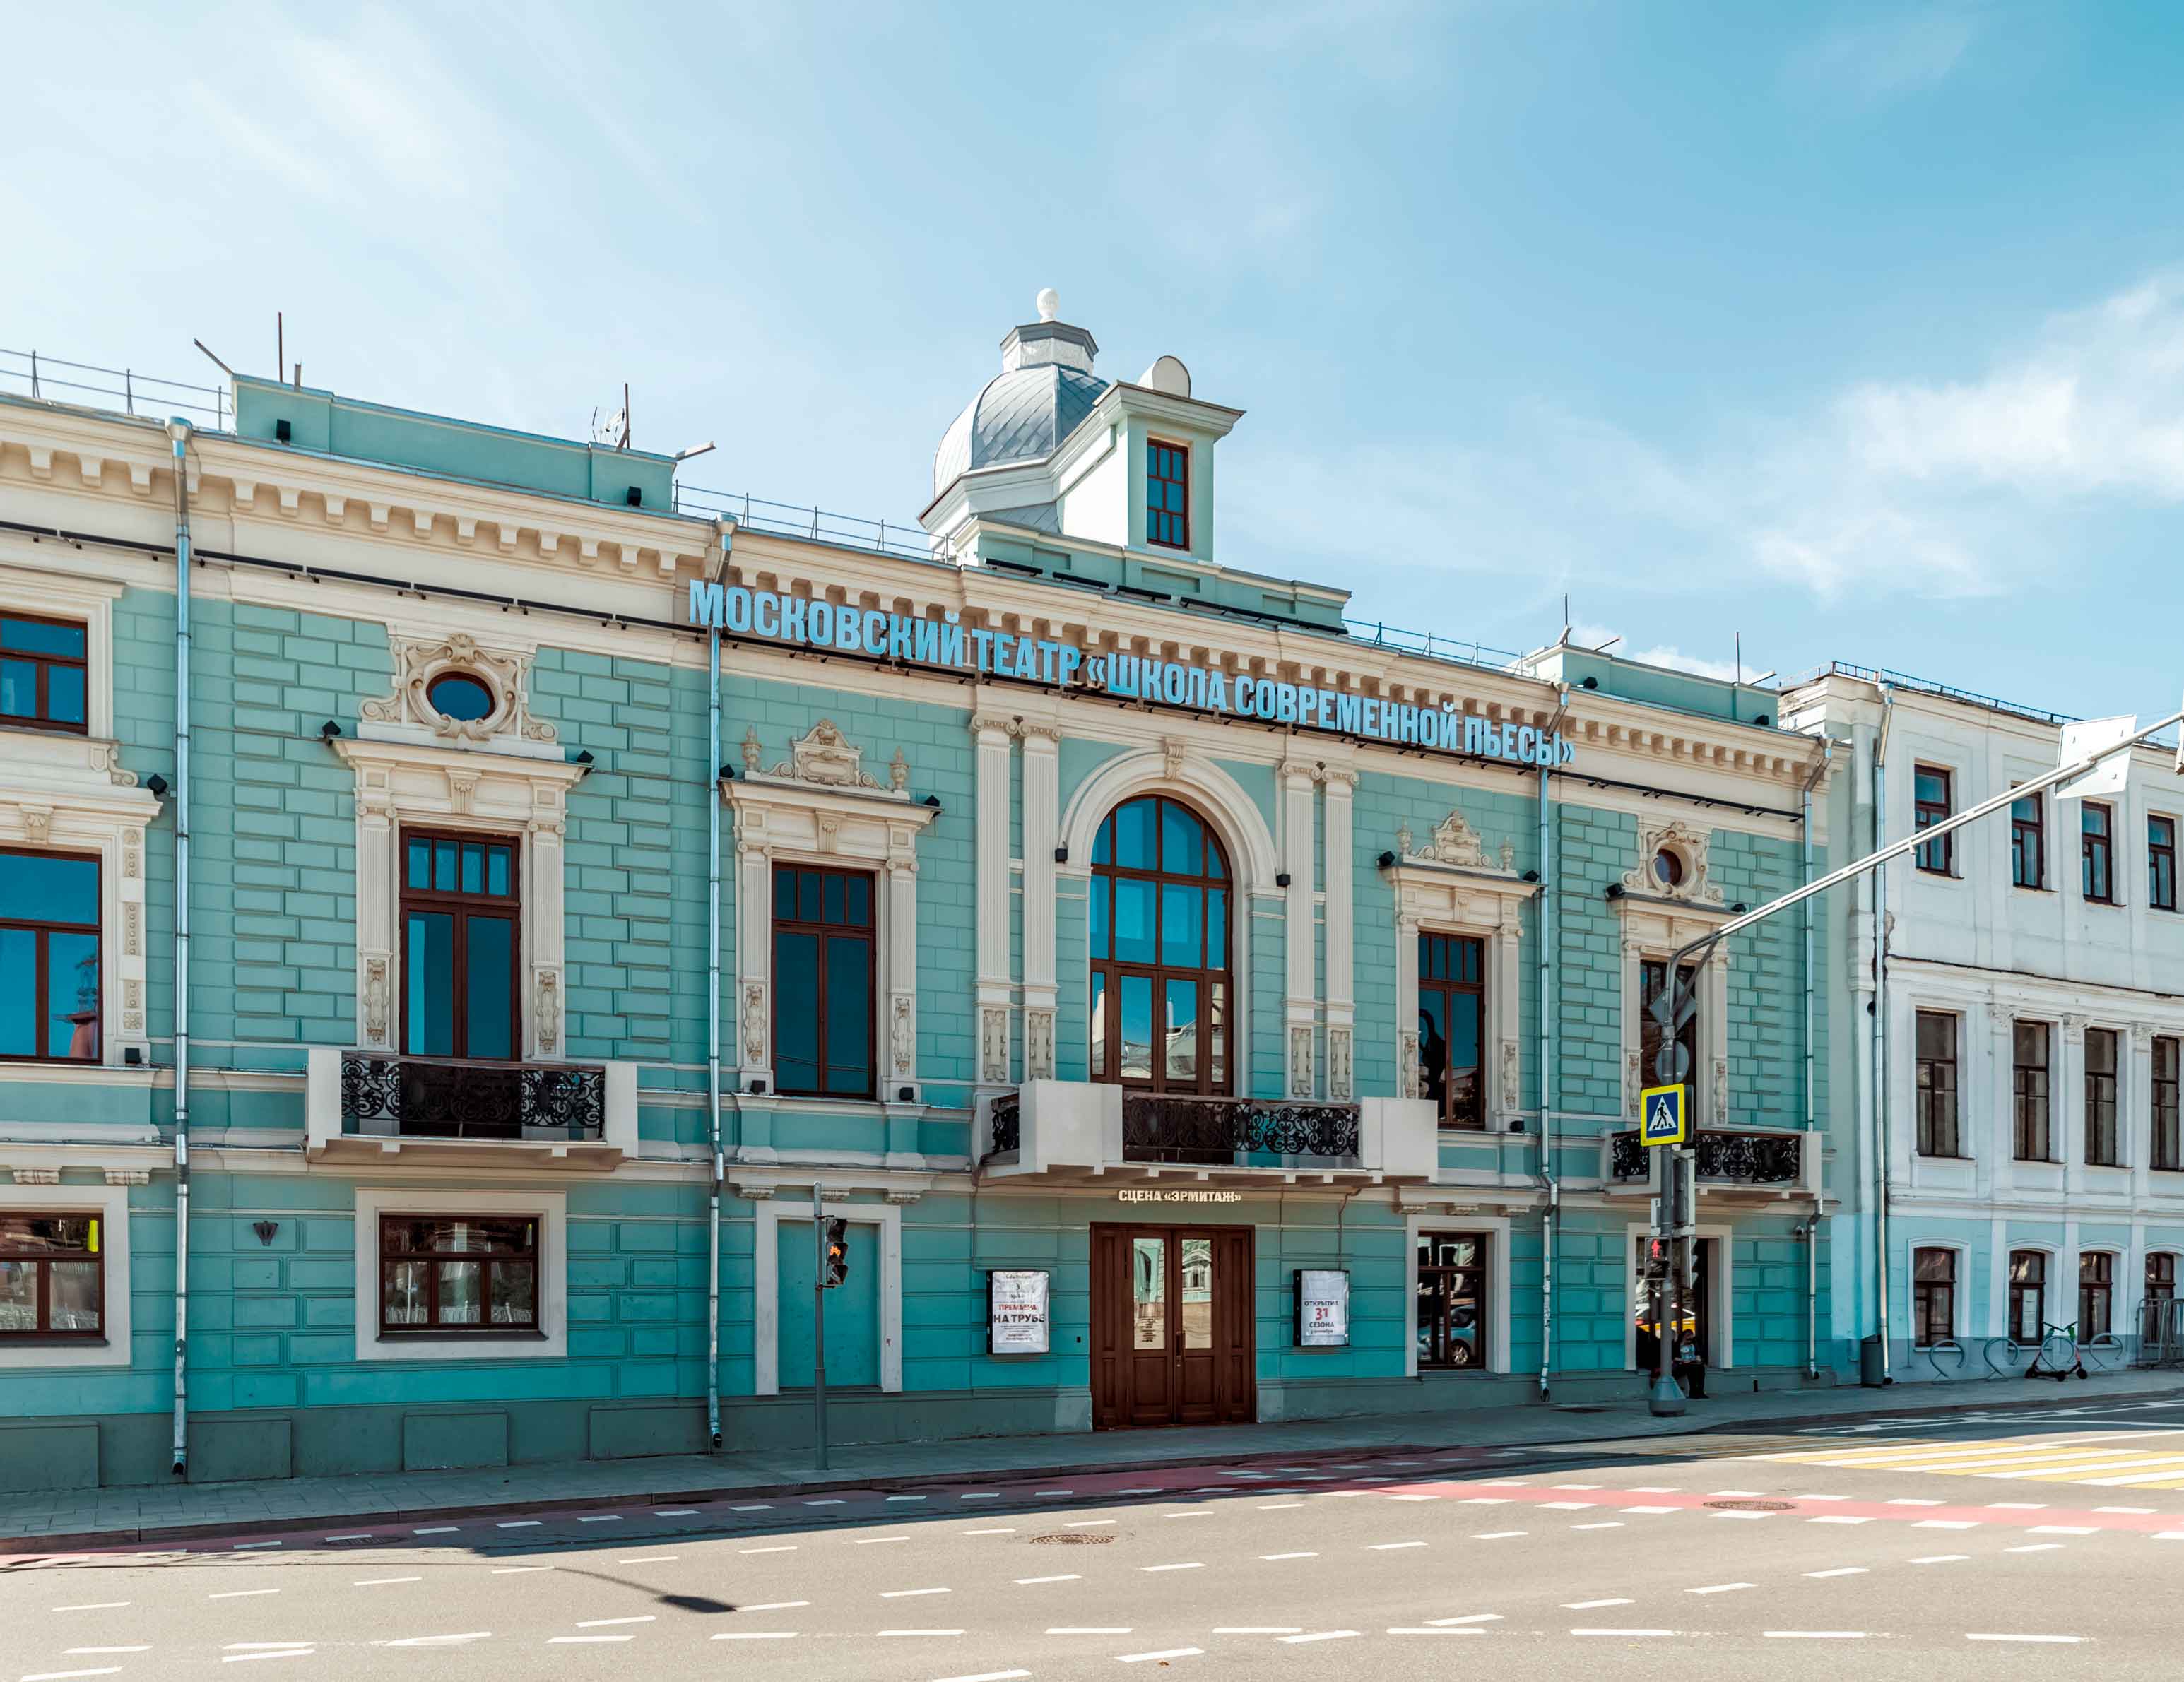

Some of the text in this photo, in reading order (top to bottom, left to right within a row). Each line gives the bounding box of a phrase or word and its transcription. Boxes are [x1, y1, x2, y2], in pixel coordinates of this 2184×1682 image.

[690, 579, 1576, 766] МОСКОВСКИЙ ТЕАТР «ШКОЛА СОВРЕМЕННОЙ ПЬЕСЫ»
[1118, 1190, 1241, 1203] СЦЕНА «ЭРМИТАЖ»
[993, 1314, 1010, 1323] НА
[1315, 1308, 1328, 1320] 31
